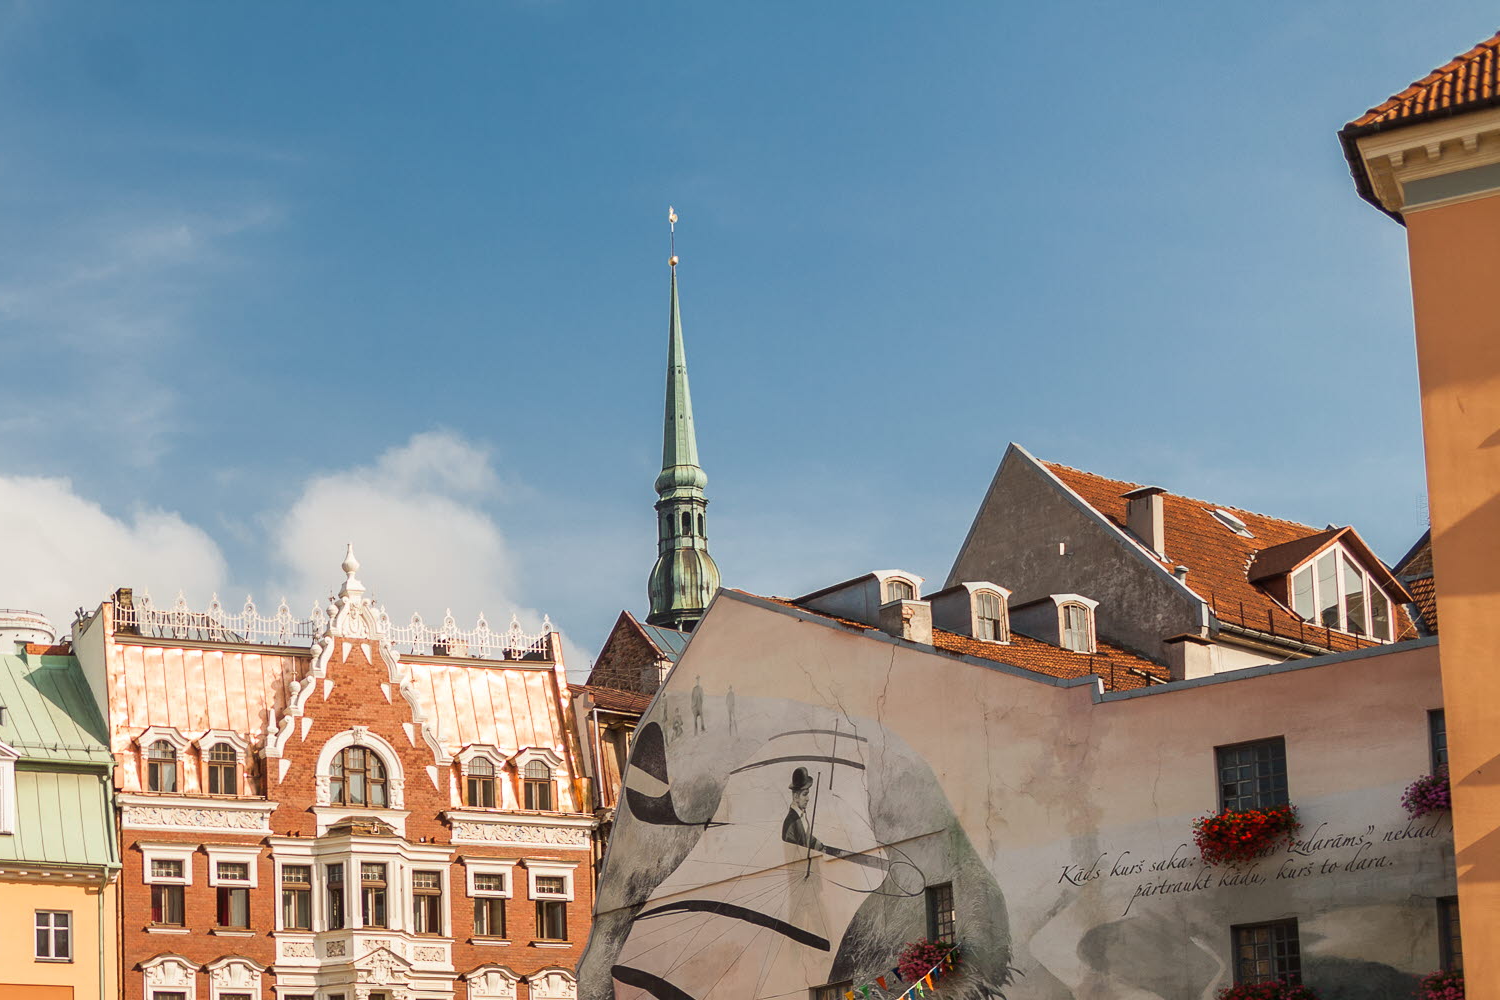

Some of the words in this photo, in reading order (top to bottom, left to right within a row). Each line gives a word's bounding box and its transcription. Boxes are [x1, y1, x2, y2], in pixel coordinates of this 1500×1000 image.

[1058, 852, 1107, 887] Kāds
[1110, 851, 1145, 877] kurš
[1149, 843, 1197, 873] saka:
[1383, 812, 1445, 842] nekad
[1122, 866, 1212, 917] pārtraukt
[1276, 859, 1312, 880] kurš
[1320, 859, 1340, 874] to
[1345, 841, 1393, 872] dara.
